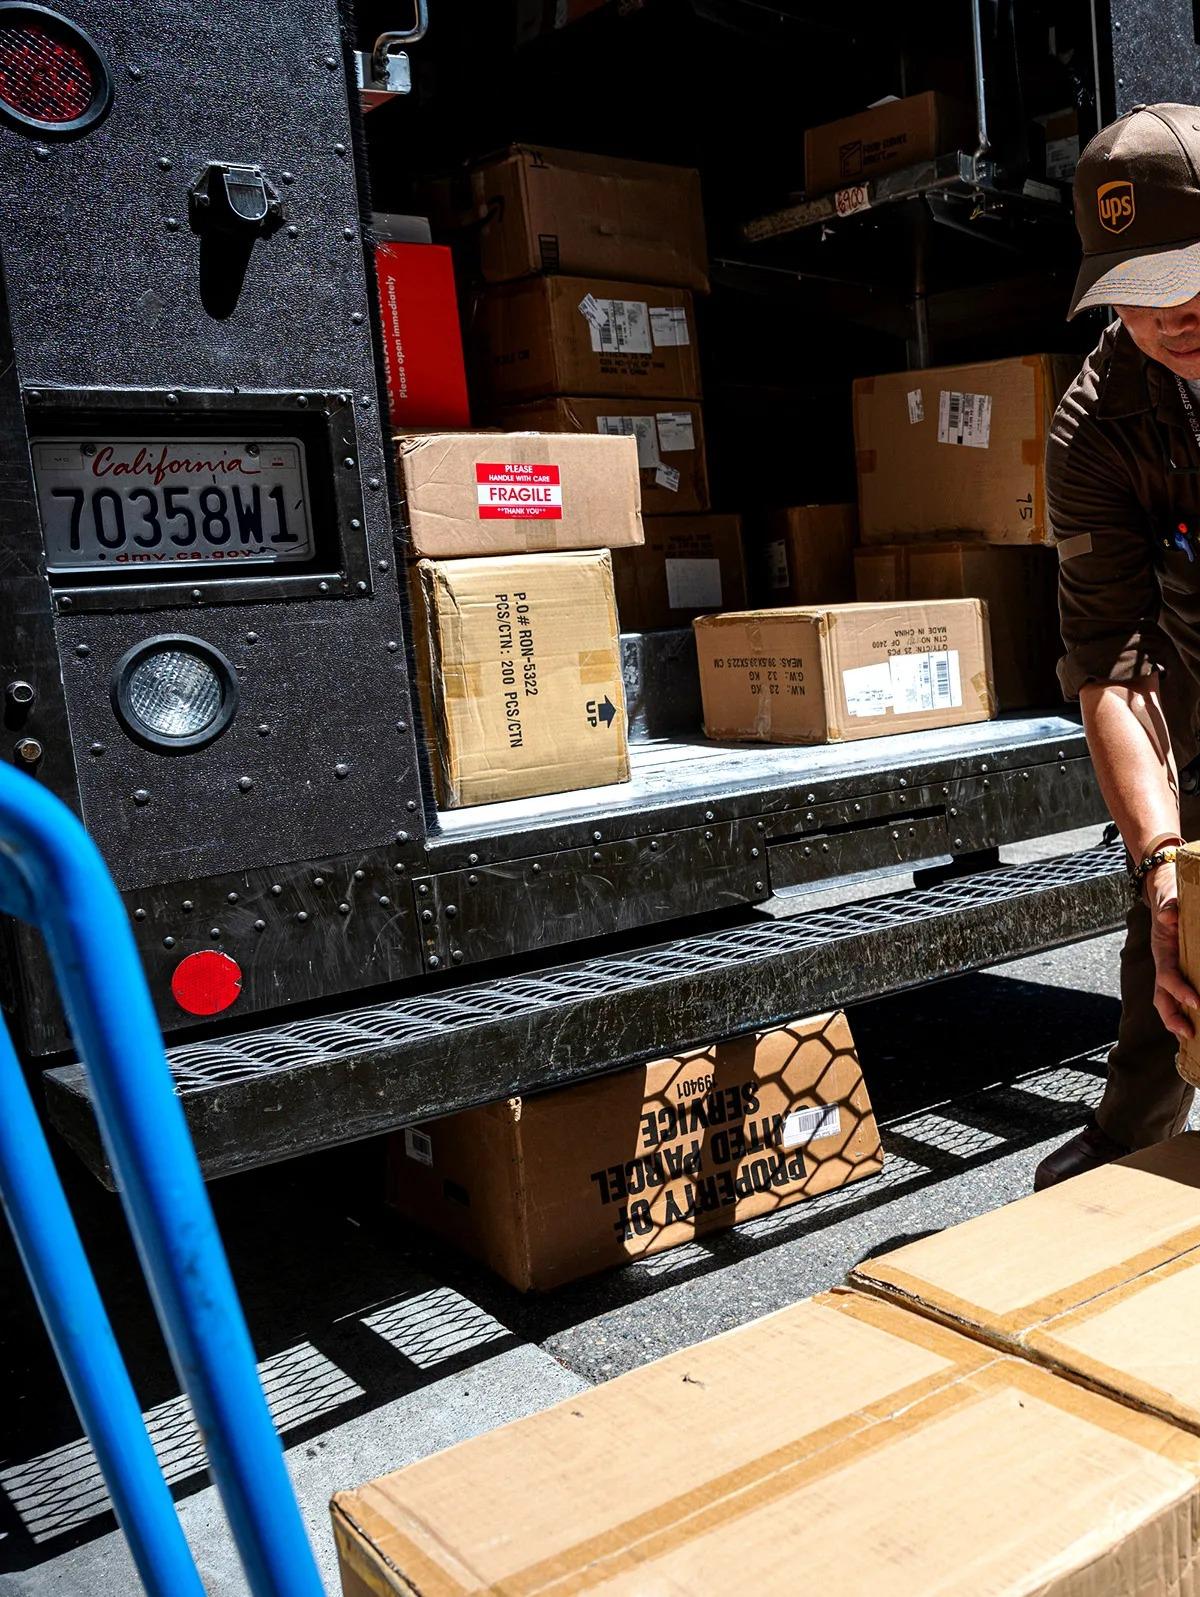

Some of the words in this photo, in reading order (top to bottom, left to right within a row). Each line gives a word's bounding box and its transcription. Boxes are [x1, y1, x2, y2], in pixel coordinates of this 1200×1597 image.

[1101, 195, 1132, 225] ups
[385, 275, 401, 338] immediately
[394, 339, 405, 365] open
[400, 366, 408, 399] Please
[92, 446, 261, 485] California
[488, 474, 514, 482] HANDLE
[504, 464, 533, 473] PLEASE
[489, 487, 551, 501] FRAGILE
[51, 485, 299, 551] 70358W1
[115, 549, 252, 563] dmv.ca.gov
[494, 593, 514, 655] PCS/CTN:
[894, 628, 915, 637] CHINA
[928, 626, 947, 634] MADE
[872, 640, 888, 649] 2400
[891, 639, 900, 647] OF
[903, 647, 912, 655] 25
[933, 635, 948, 643] CTN
[519, 629, 538, 697] RON-5322
[714, 658, 724, 669] CM
[780, 657, 803, 669] MEAS:
[887, 648, 901, 656] PCS
[501, 660, 515, 685] 200
[748, 671, 760, 681] KG
[750, 684, 762, 695] KG
[504, 691, 523, 748] PCS/CTN
[585, 700, 598, 728] UP
[677, 1073, 717, 1099] 199401
[640, 1080, 761, 1148] SERVICE
[711, 1104, 811, 1165] NITED
[591, 1139, 701, 1205] PARCEL
[664, 1149, 809, 1226] PROPERTY
[614, 1199, 654, 1244] OF
